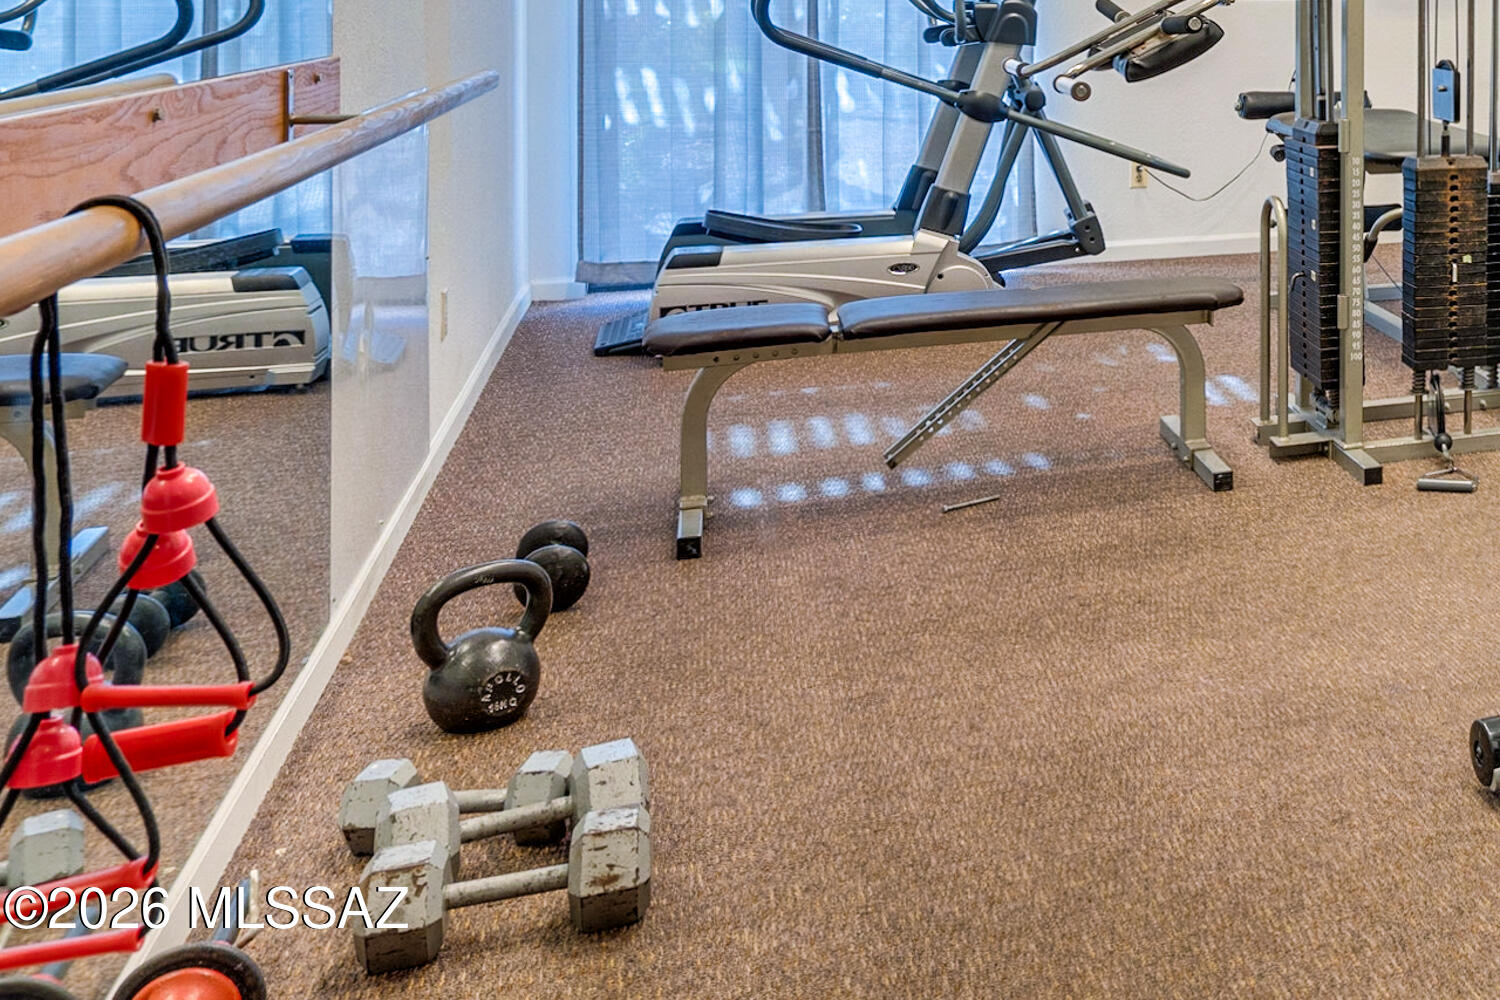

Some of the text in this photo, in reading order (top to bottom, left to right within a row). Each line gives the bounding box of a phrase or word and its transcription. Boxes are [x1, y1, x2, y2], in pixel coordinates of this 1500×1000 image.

[1352, 168, 1360, 176] 15
[1352, 211, 1360, 219] 35
[1352, 244, 1360, 252] 50
[1352, 276, 1360, 284] 65
[1352, 298, 1360, 306] 75
[1352, 309, 1360, 317] 80
[1352, 320, 1360, 328] 85
[481, 673, 526, 702] APOLLO
